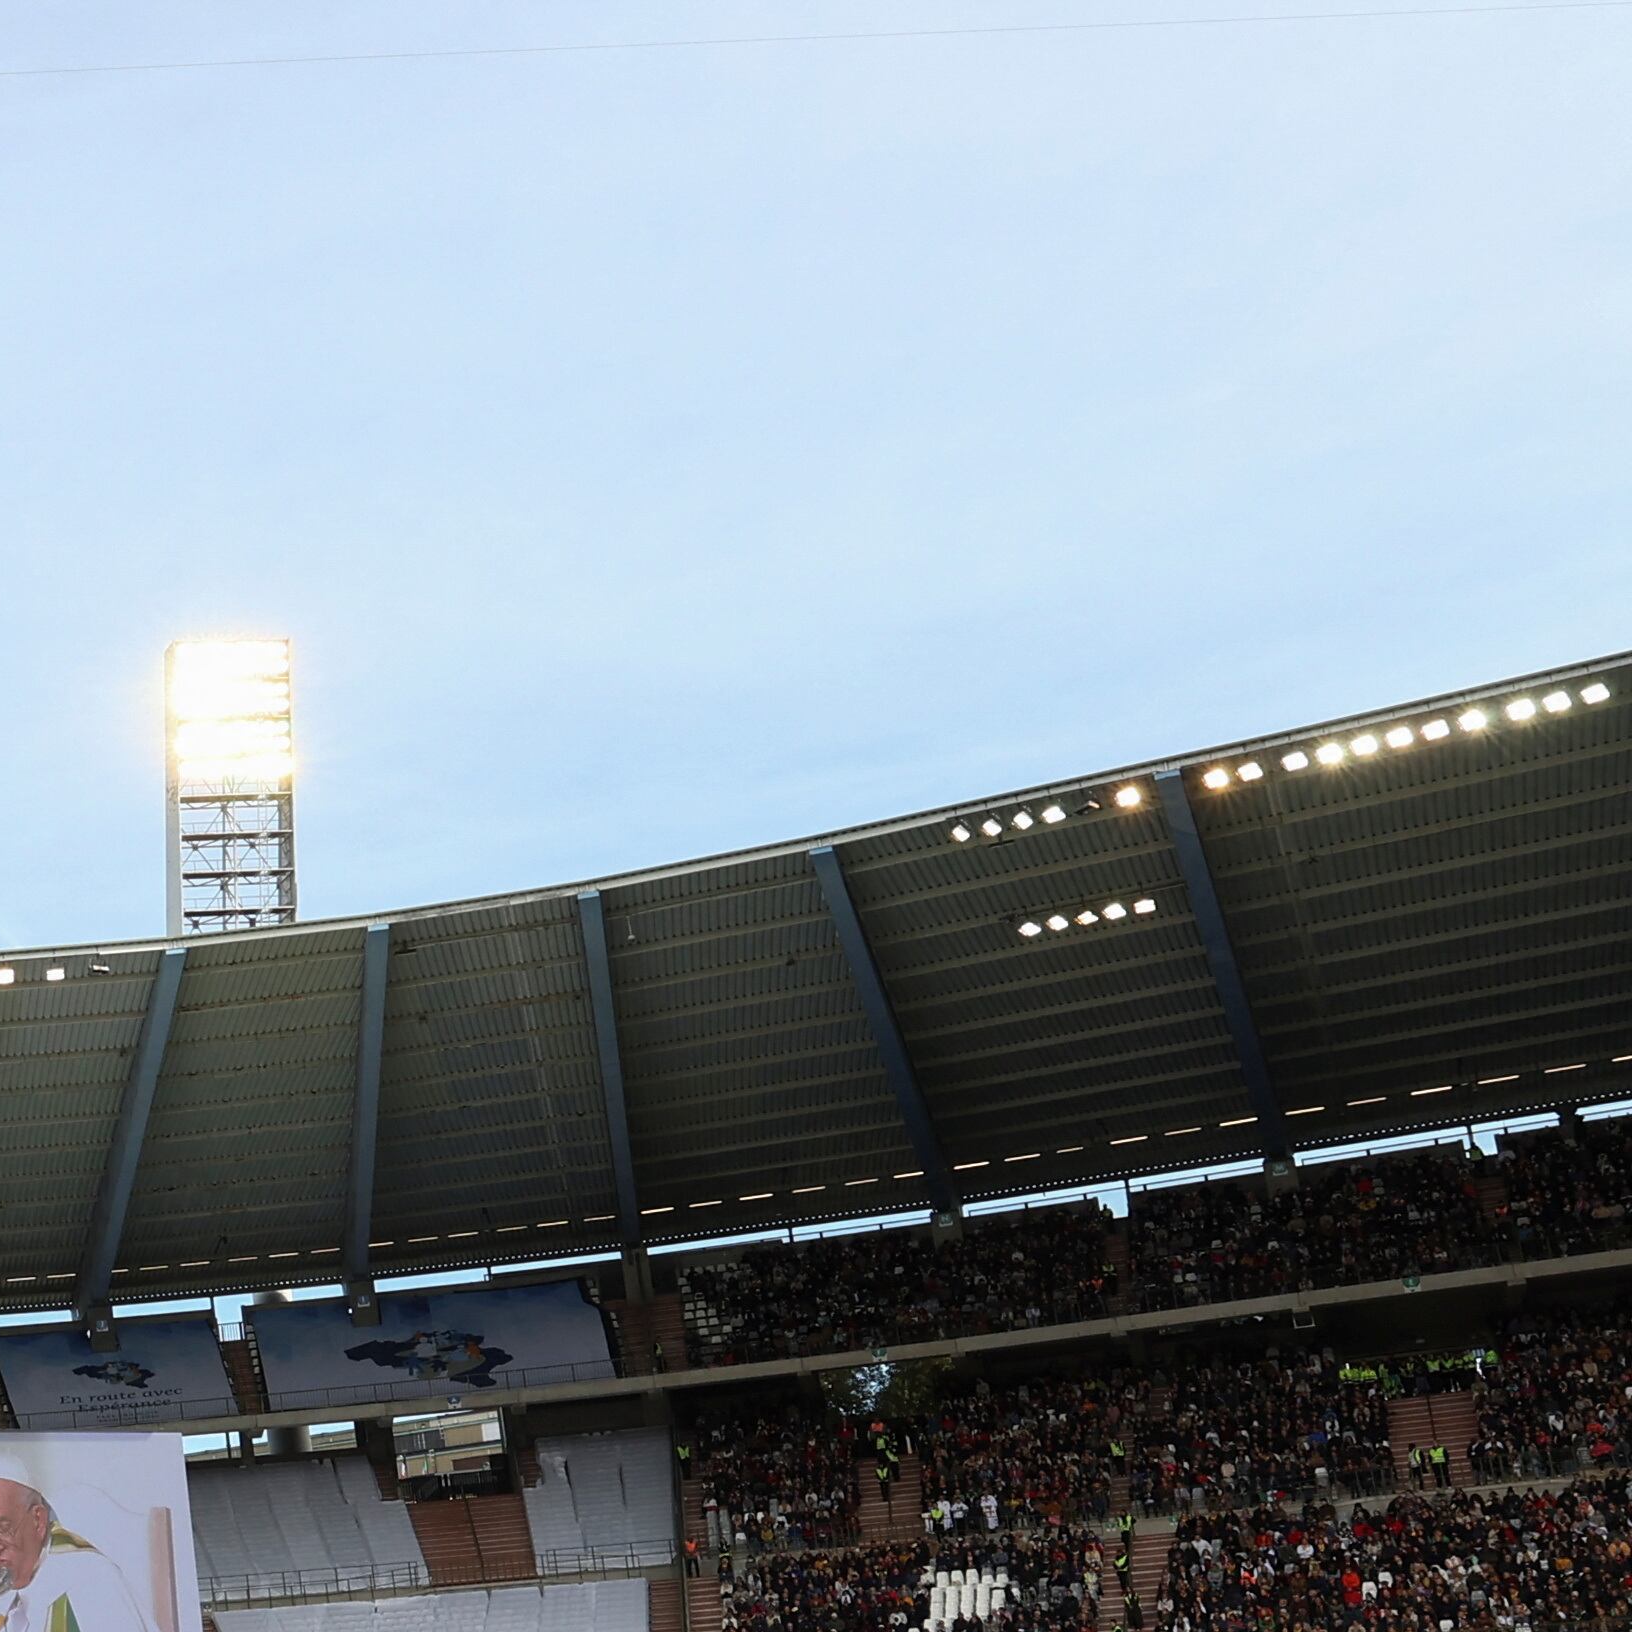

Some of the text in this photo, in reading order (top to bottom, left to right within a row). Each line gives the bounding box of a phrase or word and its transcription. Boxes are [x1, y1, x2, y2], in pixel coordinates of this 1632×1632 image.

[60, 1388, 184, 1405] En route avec
